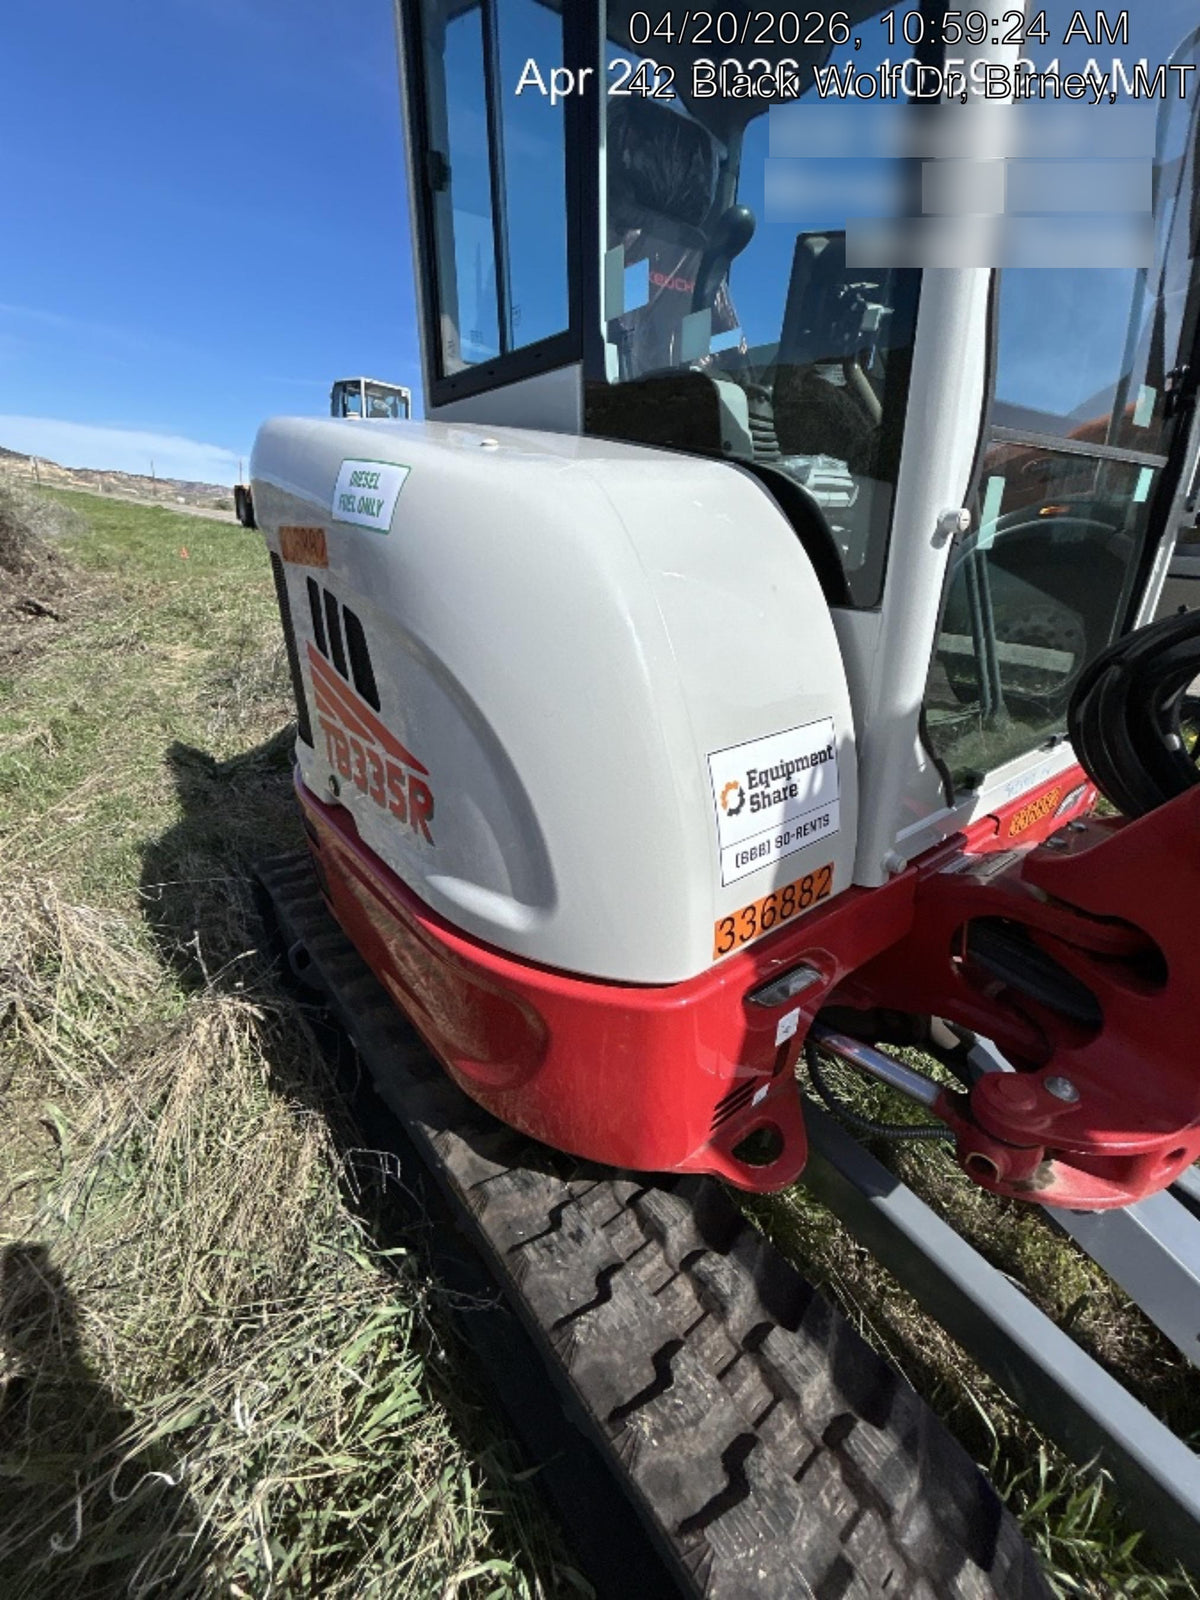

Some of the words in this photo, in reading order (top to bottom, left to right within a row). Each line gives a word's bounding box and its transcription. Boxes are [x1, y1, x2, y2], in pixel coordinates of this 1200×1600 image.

[349, 470, 381, 490] DIESEL
[338, 493, 356, 513] FUEL
[357, 495, 385, 518] ONLY
[319, 718, 436, 846] TB335R
[746, 744, 835, 790] Equipment
[749, 784, 798, 814] Share
[718, 866, 831, 954] 336882
